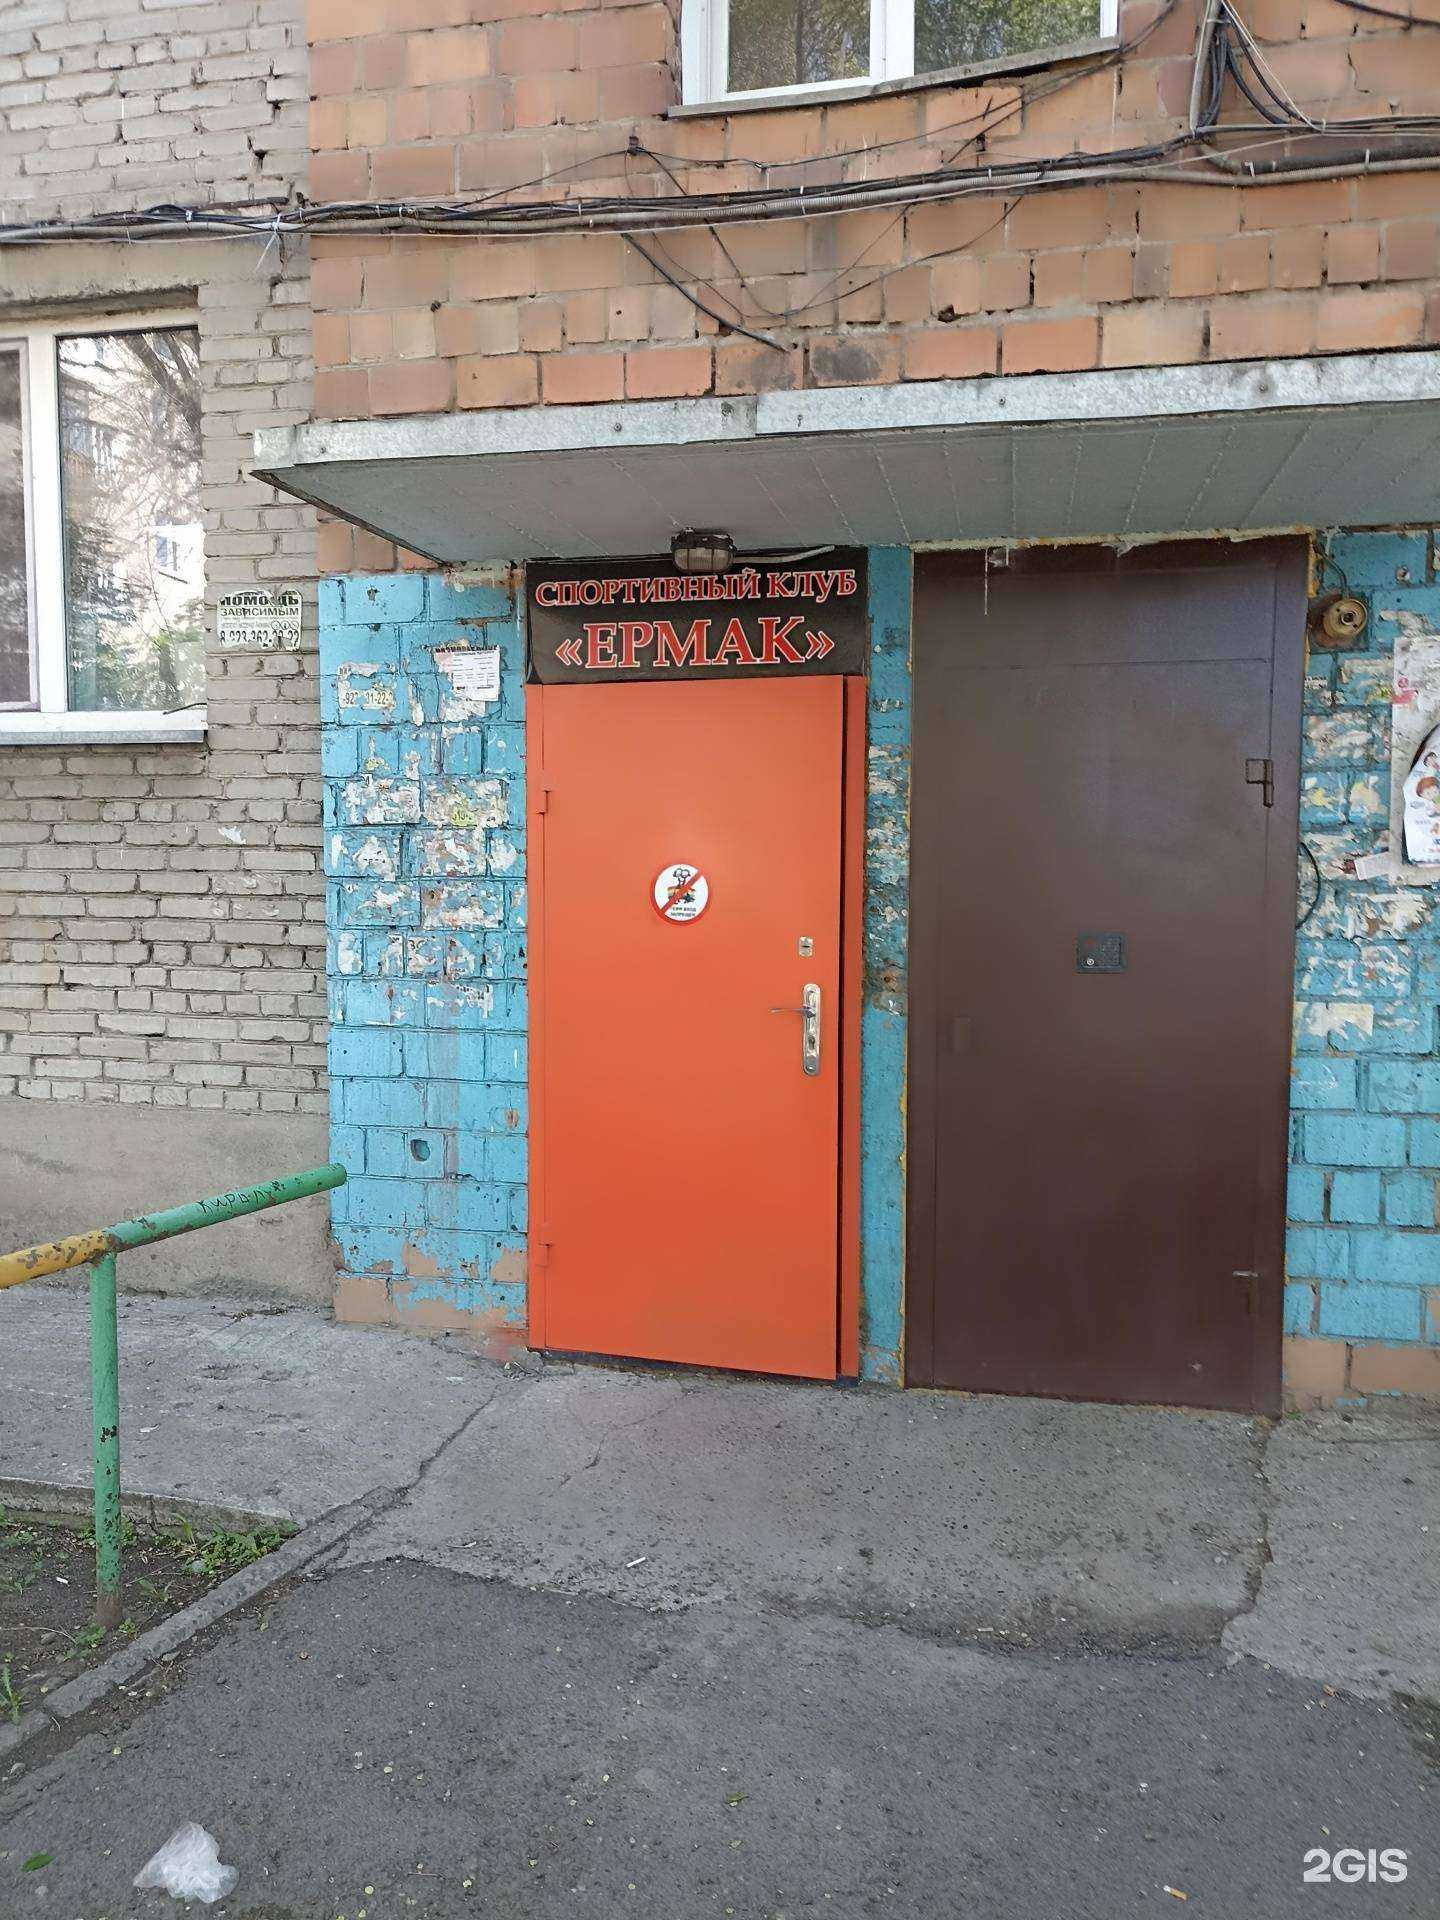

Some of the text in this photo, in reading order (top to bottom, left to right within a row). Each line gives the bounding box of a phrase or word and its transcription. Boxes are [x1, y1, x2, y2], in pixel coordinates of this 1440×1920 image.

[535, 567, 858, 607] СПОРТИВНЫЙ КЛУБ
[220, 607, 299, 617] ЗАВИСИМЫМ
[555, 616, 835, 669] «ЕРМАК»
